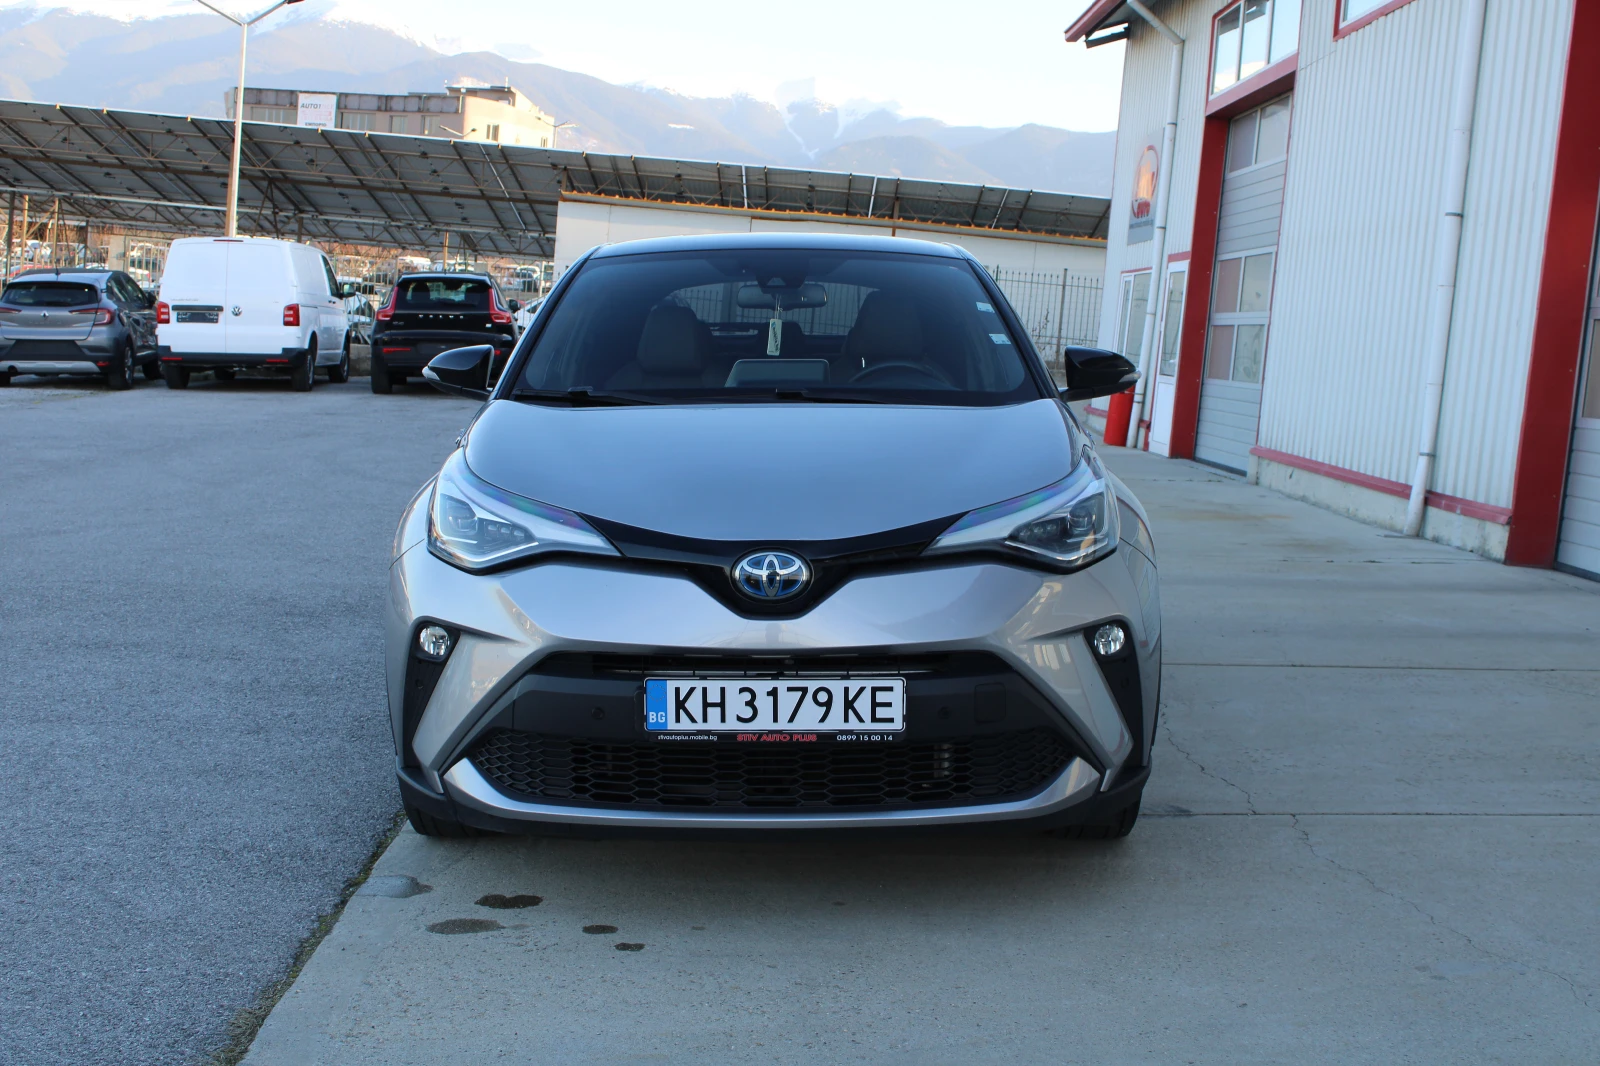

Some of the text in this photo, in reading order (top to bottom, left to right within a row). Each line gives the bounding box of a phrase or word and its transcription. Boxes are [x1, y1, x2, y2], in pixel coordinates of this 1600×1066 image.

[649, 712, 666, 723] BG
[736, 733, 818, 741] STIV AUTO PLUS
